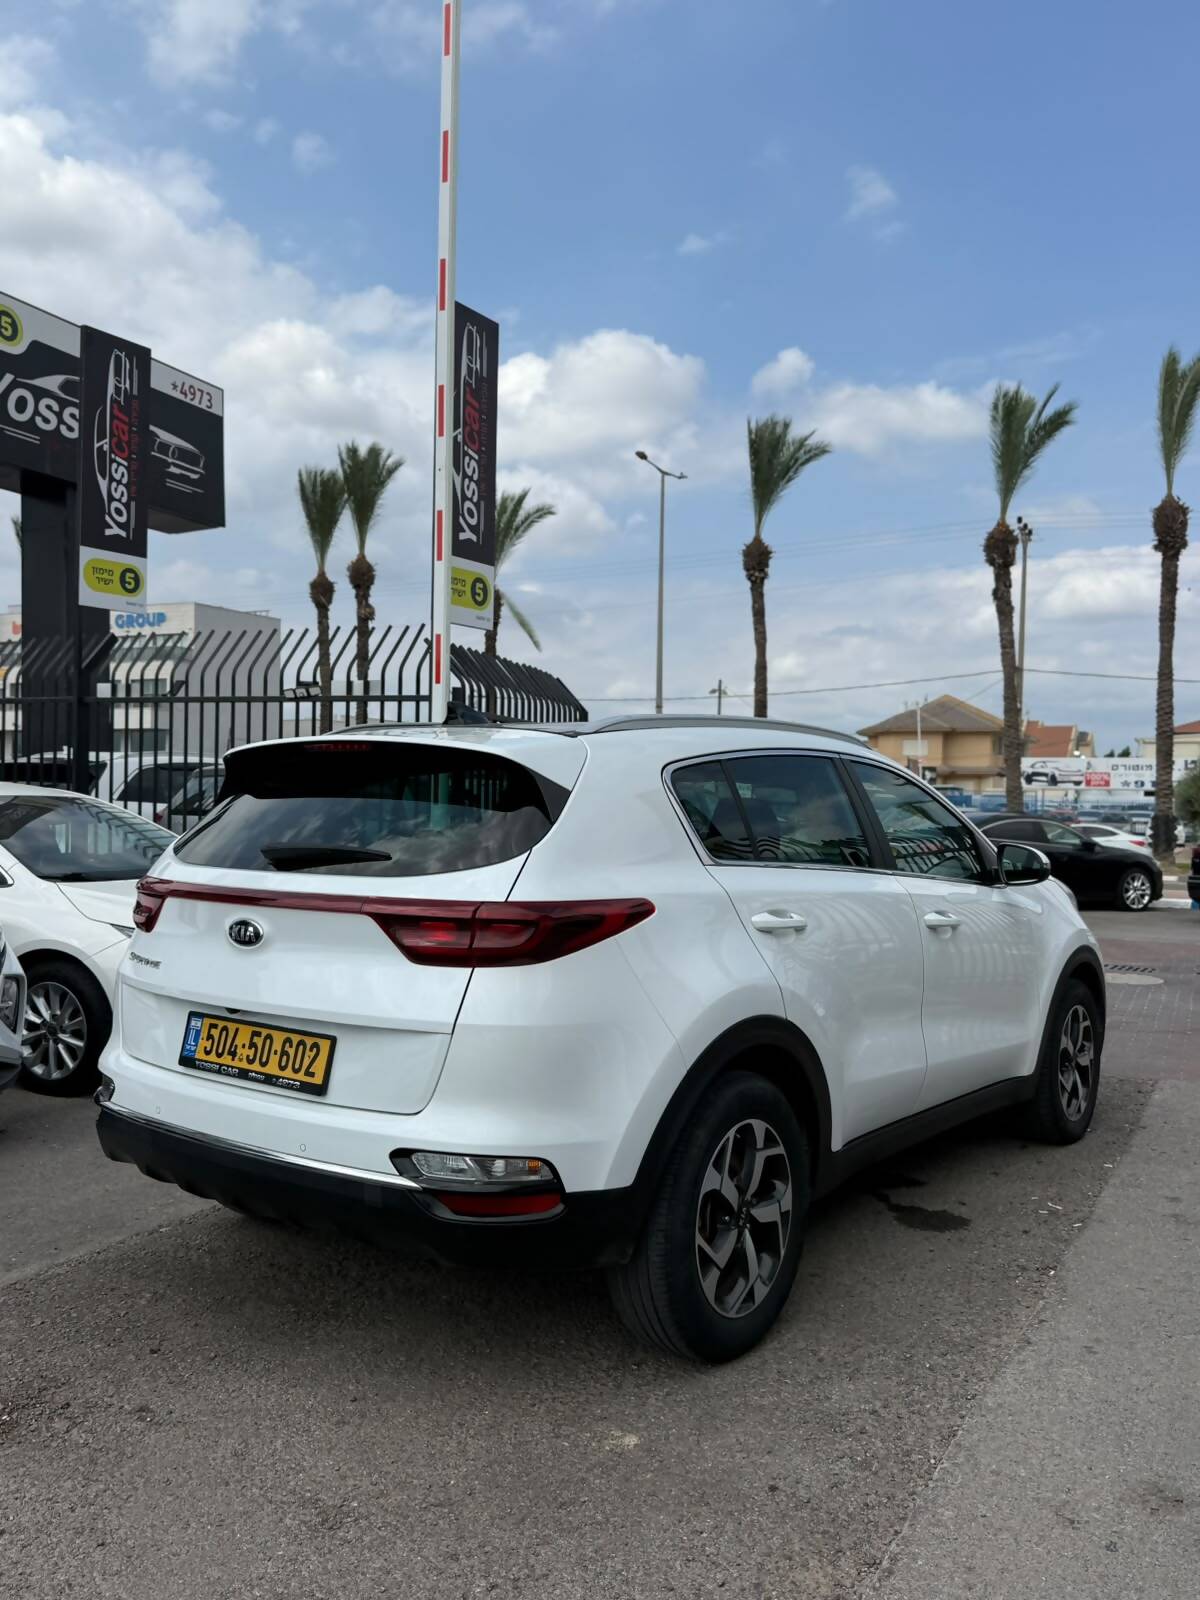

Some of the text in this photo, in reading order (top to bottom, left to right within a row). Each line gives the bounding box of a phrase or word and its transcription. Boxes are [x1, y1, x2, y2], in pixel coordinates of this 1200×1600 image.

[0, 315, 13, 338] 5
[91, 566, 136, 590] מימון 5
[96, 577, 114, 587] ישיר
[475, 582, 484, 602] 5
[115, 611, 168, 629] GROUP
[230, 924, 258, 943] KIA
[195, 1060, 219, 1072] YOSSI
[220, 1065, 239, 1077] CAR
